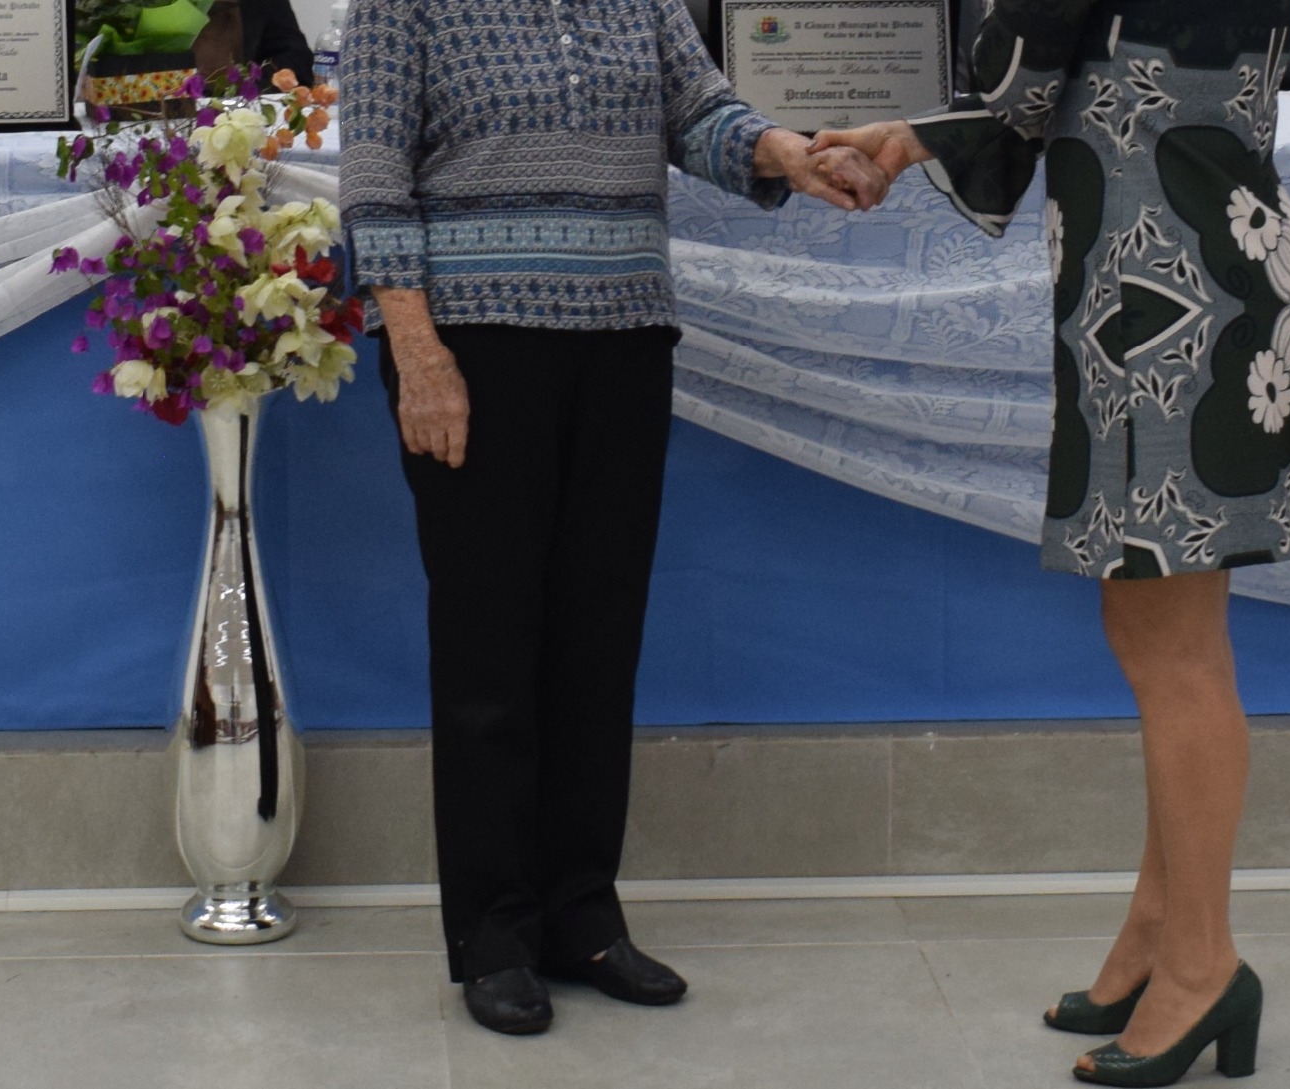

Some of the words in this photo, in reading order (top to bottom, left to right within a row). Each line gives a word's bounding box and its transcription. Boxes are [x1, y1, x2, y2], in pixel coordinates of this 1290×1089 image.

[838, 21, 878, 30] Municipal
[784, 88, 844, 101] Professora
[847, 87, 891, 100] Emérita
